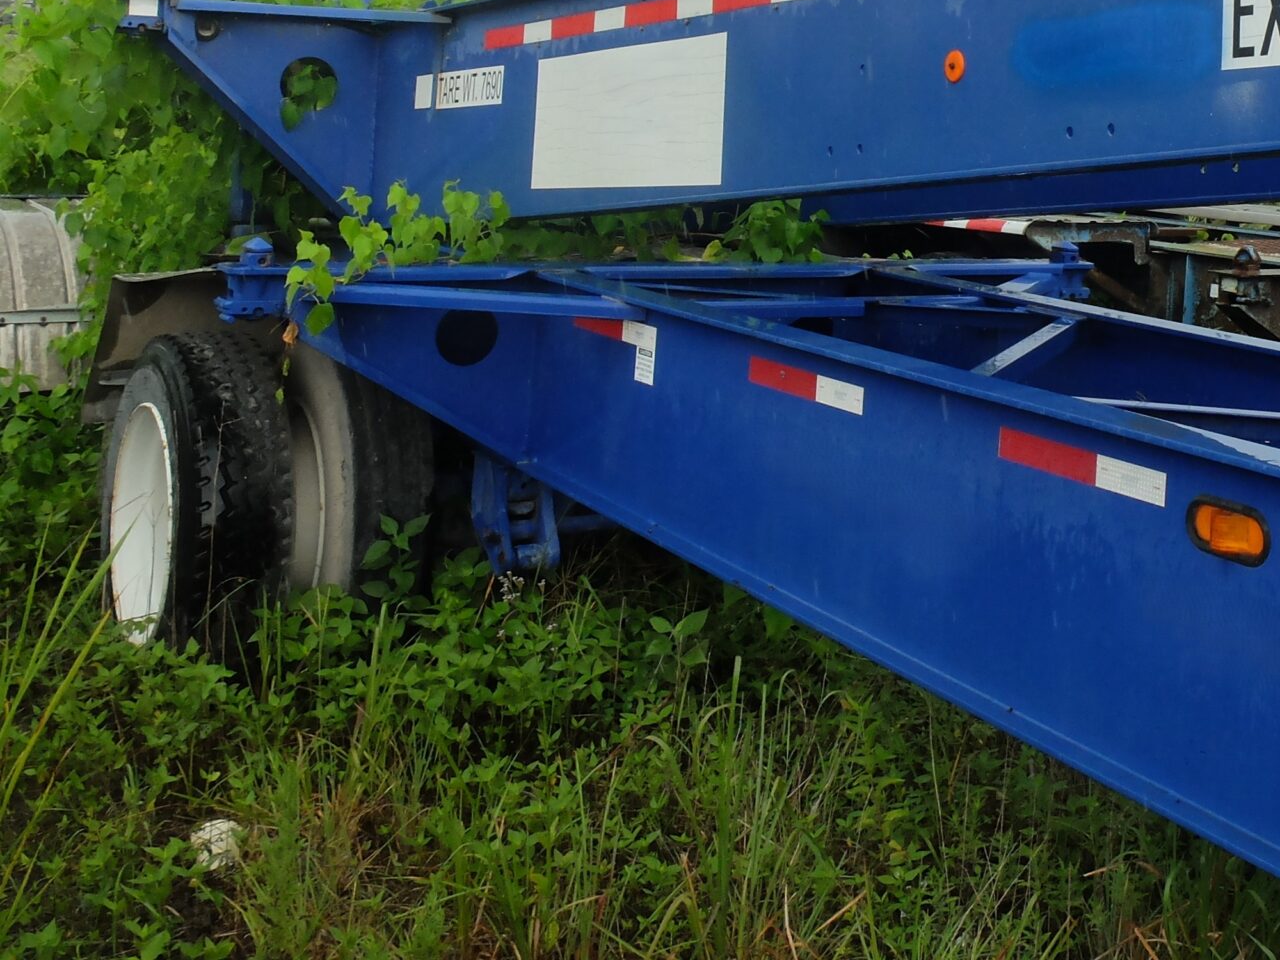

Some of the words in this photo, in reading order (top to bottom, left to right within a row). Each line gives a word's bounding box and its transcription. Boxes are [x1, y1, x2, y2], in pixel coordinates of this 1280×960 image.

[438, 74, 460, 105] TARE
[462, 72, 478, 103] WT.
[481, 71, 502, 100] 7690
